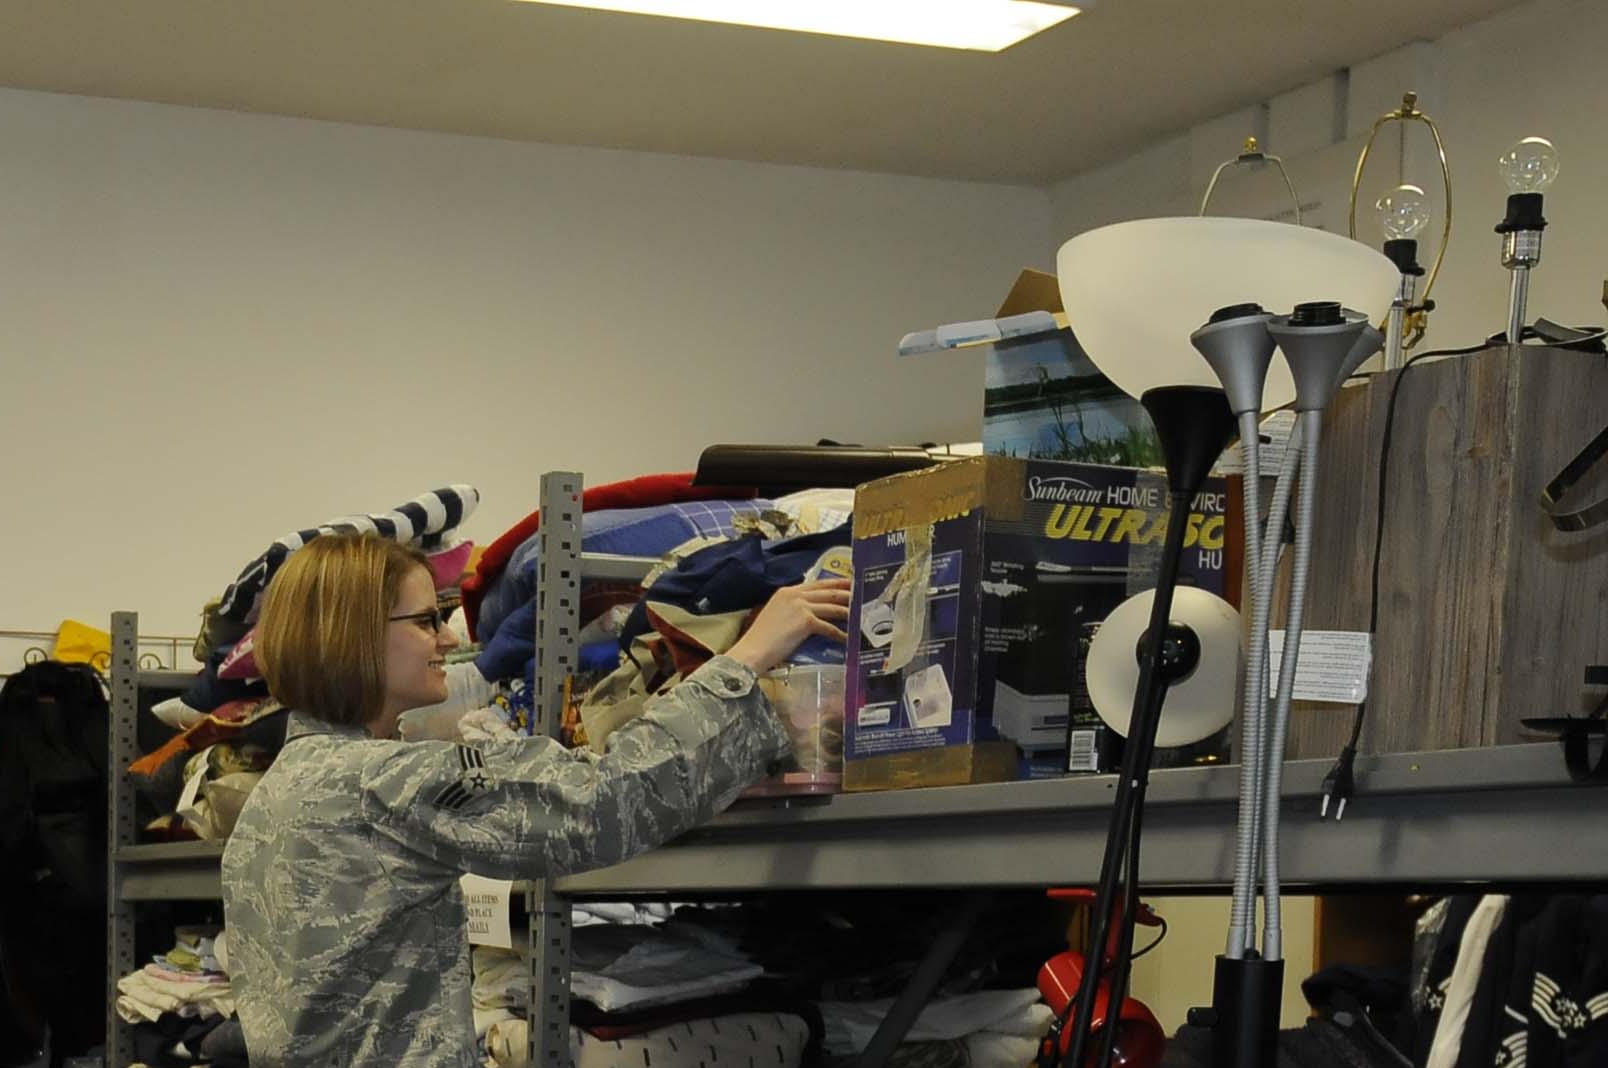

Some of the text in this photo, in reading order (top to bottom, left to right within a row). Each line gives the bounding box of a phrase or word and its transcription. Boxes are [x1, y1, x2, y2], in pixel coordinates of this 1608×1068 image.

[1024, 476, 1103, 504] Sunbeam
[1107, 486, 1158, 506] HOME
[1045, 504, 1225, 550] ULTRASO
